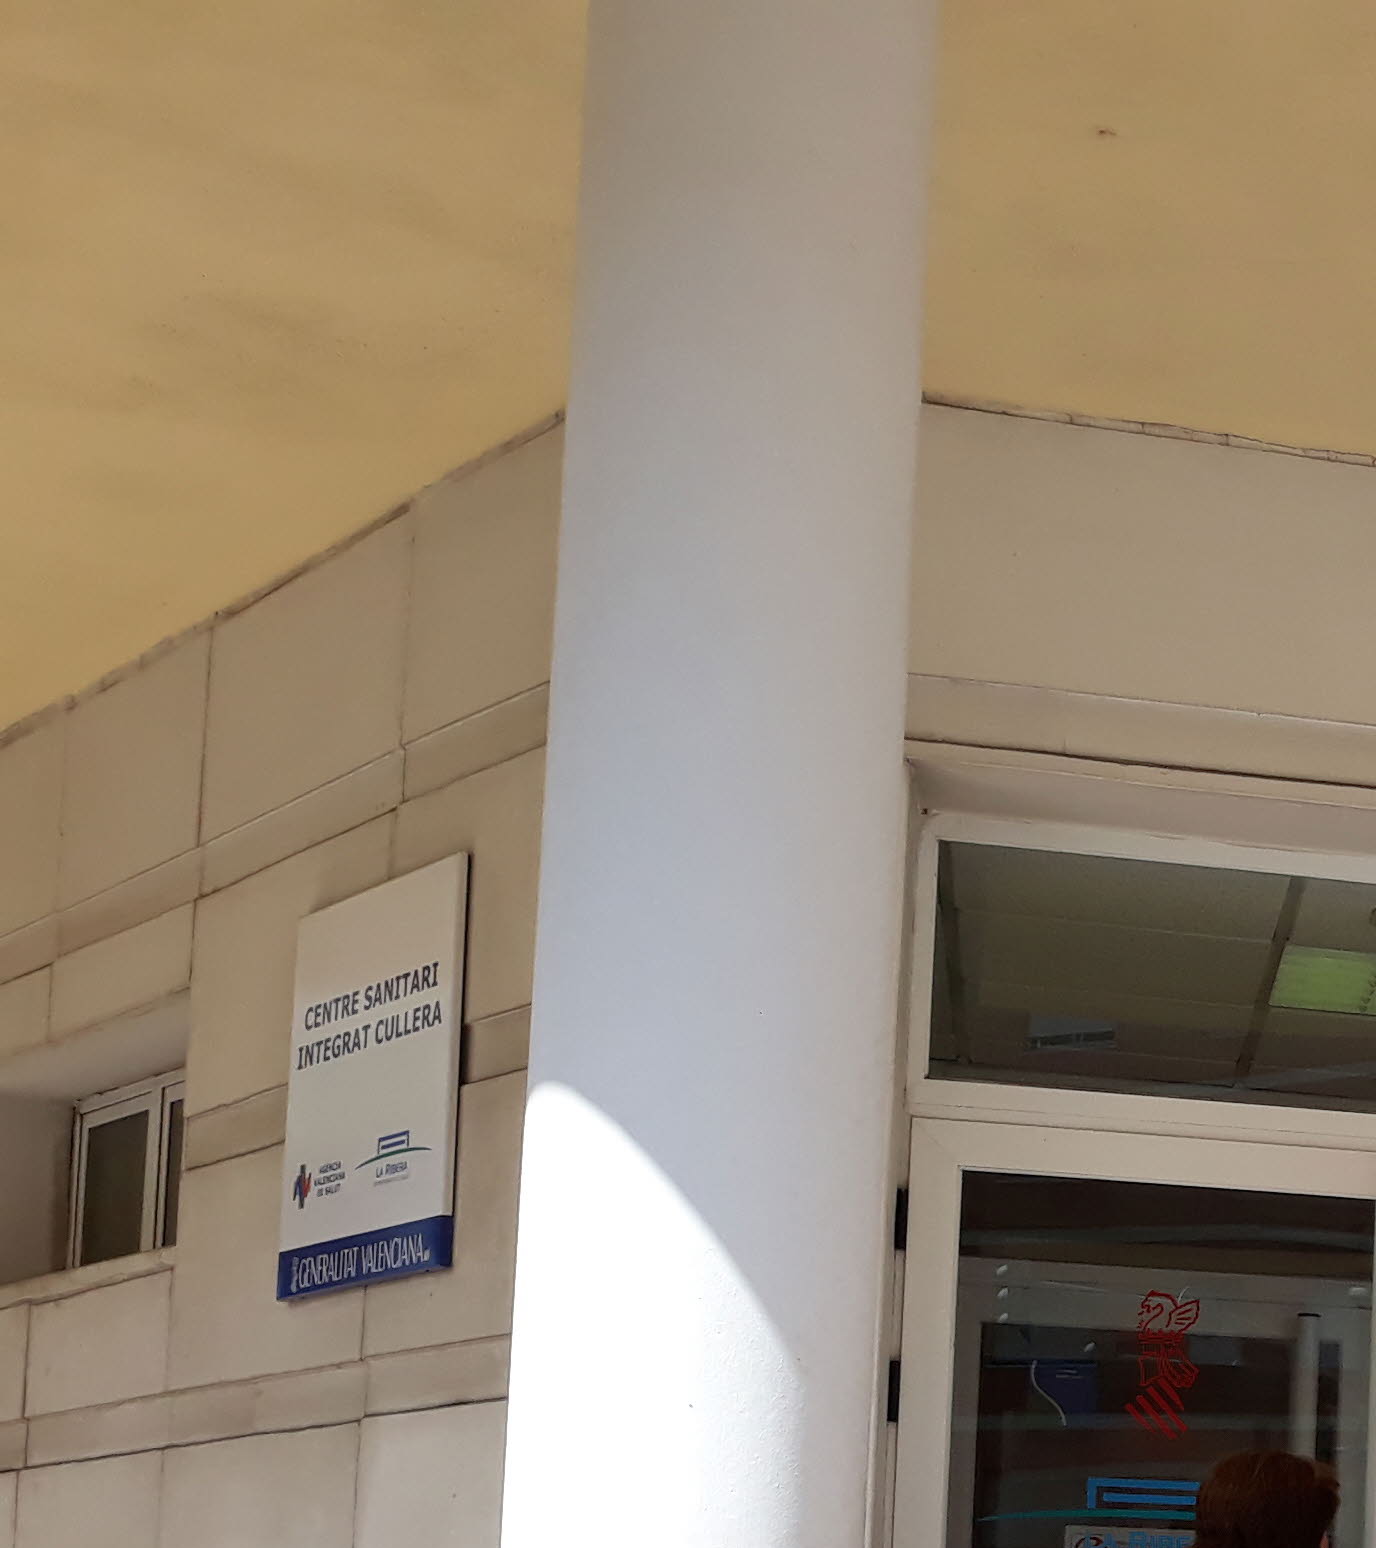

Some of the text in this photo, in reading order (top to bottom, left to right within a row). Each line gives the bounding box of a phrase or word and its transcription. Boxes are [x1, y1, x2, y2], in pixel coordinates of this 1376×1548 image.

[304, 961, 439, 1031] CENTRE SANITARI
[297, 1000, 442, 1071] INTEGRAT CULLERA
[299, 1232, 425, 1289] GENERALITAT VALENCIANA
